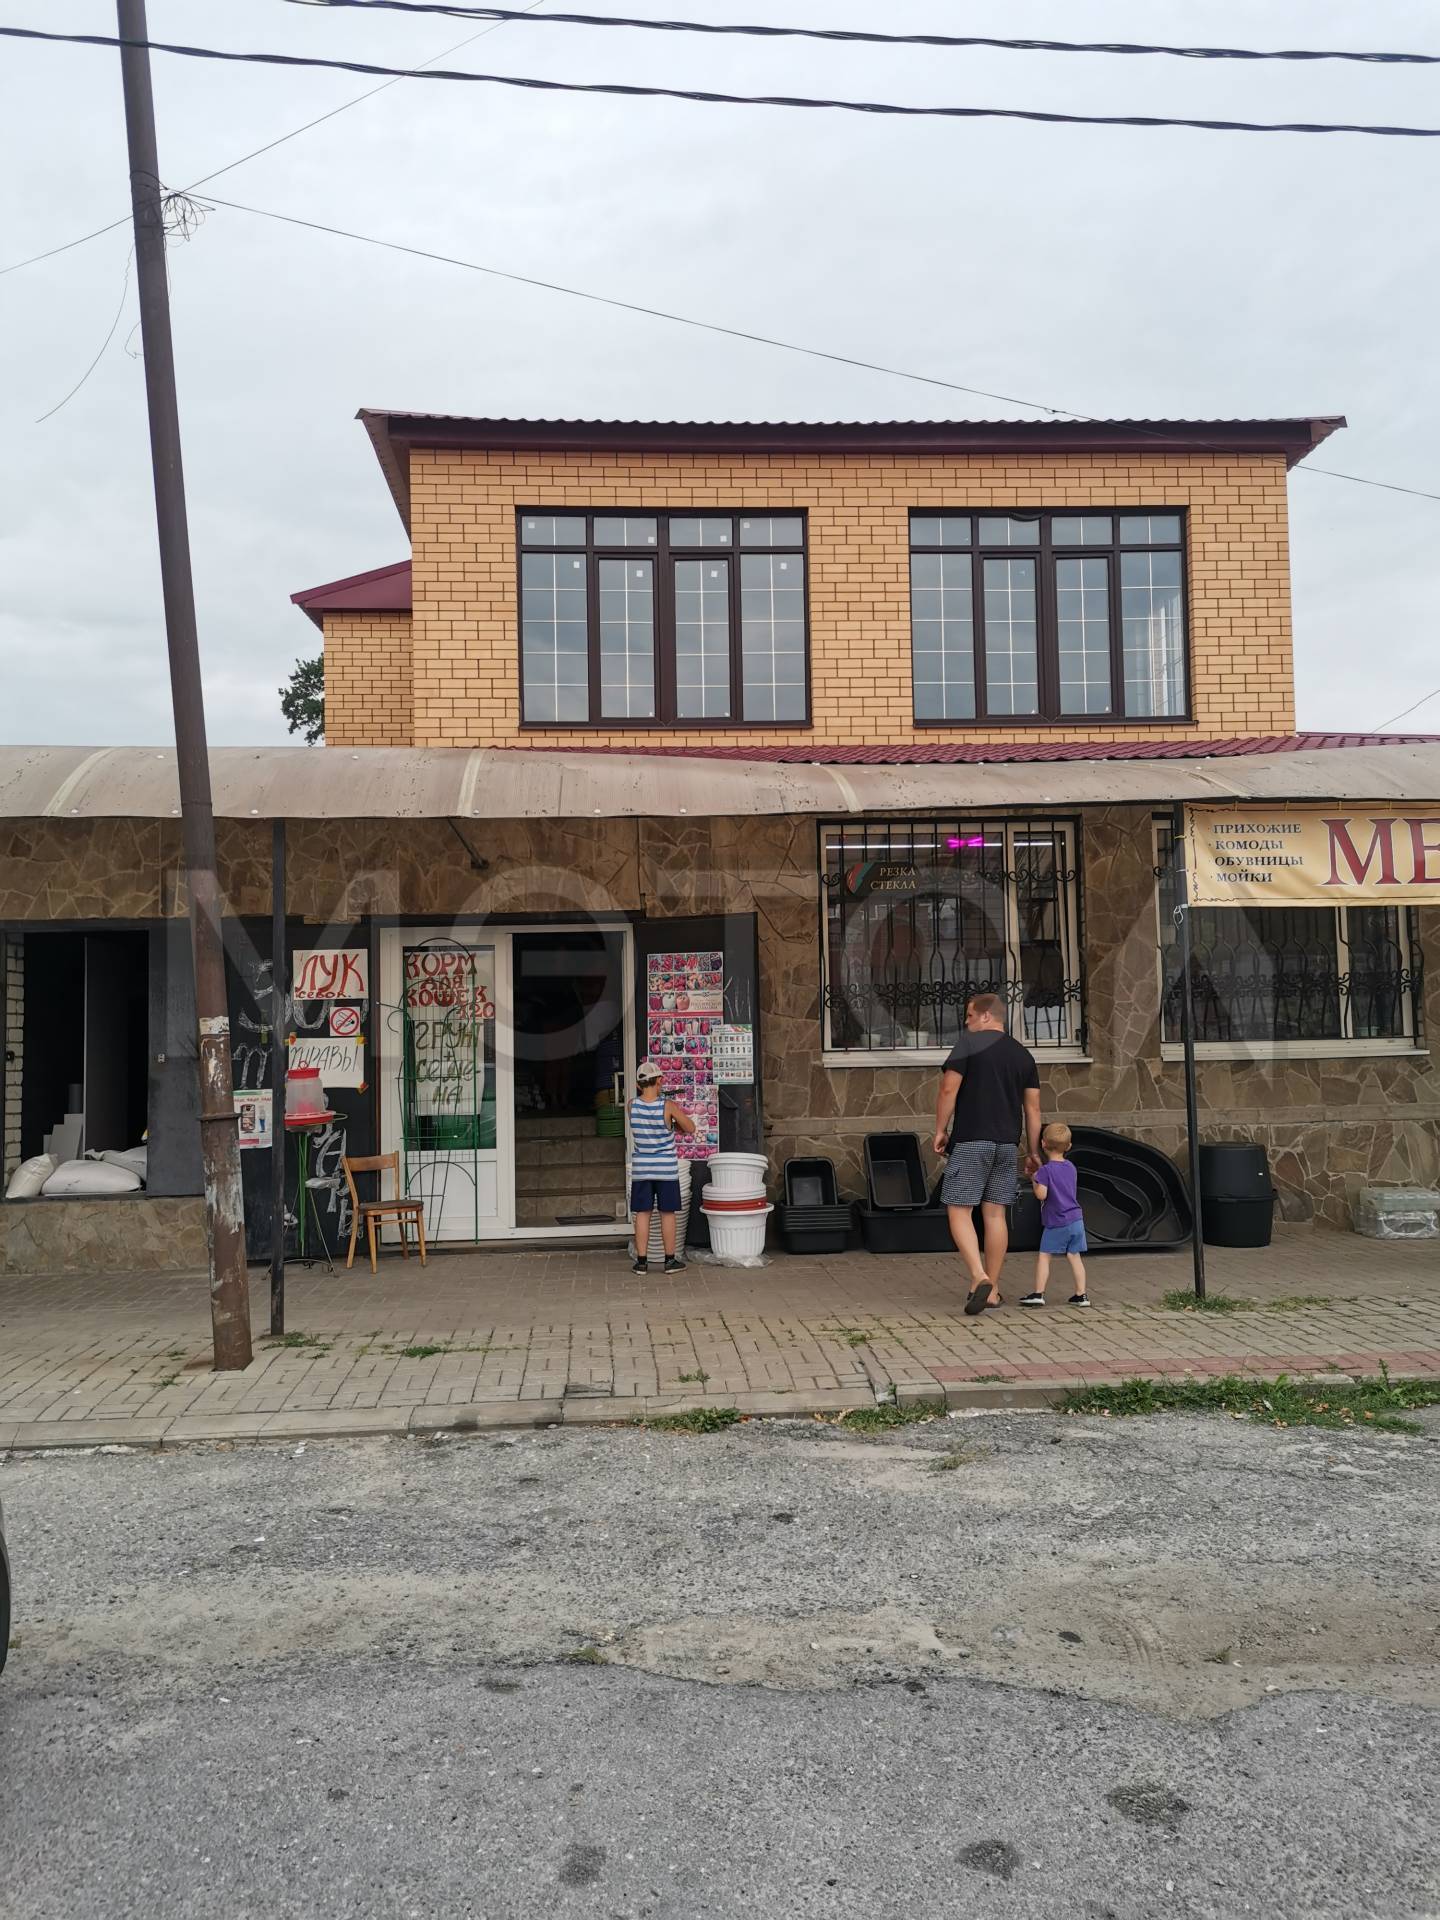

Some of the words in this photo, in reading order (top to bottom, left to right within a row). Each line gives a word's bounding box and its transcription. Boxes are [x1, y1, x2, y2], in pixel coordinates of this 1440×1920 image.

[1213, 824, 1302, 834] ПРИХОЖИЕ
[1215, 840, 1283, 851] КОМОДЫ
[1215, 856, 1304, 867] ОБУВНИЦЫ
[879, 867, 916, 876] РЕЗКА
[1216, 869, 1273, 883] МОЙКИ
[870, 880, 916, 890] СТЕКЛА
[405, 952, 478, 980] КОРМ
[295, 954, 365, 993] ЛУК
[406, 985, 488, 1008] КОШЕК
